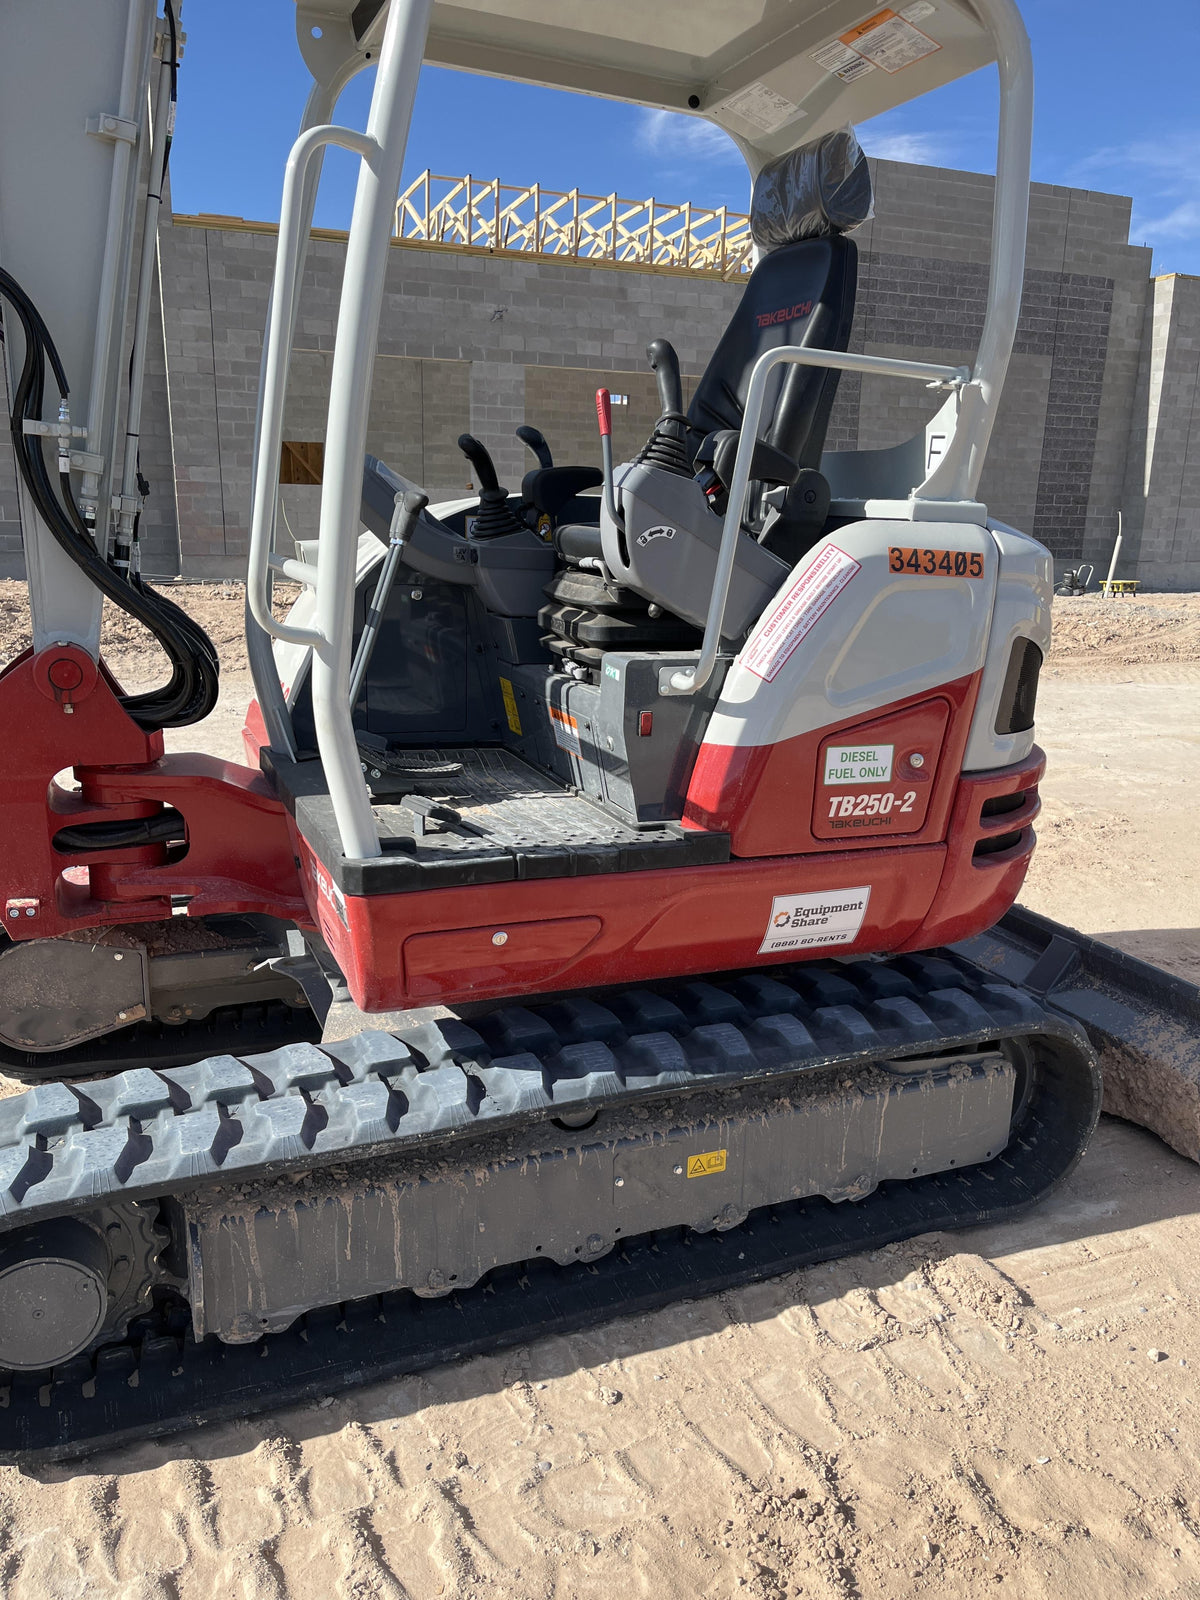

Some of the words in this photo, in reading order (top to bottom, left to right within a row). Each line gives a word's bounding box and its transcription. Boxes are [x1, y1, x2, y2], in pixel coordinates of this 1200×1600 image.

[756, 300, 812, 328] TAKEUCHI
[927, 435, 946, 470] F
[890, 547, 982, 577] 343405
[763, 599, 794, 637] CUSTOMER
[791, 546, 835, 601] RESPONSIBILITY
[815, 583, 840, 612] MAINTENANCE
[840, 751, 878, 763] DIESEL
[828, 768, 856, 779] FUEL
[859, 766, 888, 778] ONLY
[828, 791, 917, 817] TB250-2
[828, 817, 892, 829] TAKEUCHI
[793, 901, 863, 918] Equipment
[791, 917, 829, 928] Share
[771, 939, 799, 949] (888)
